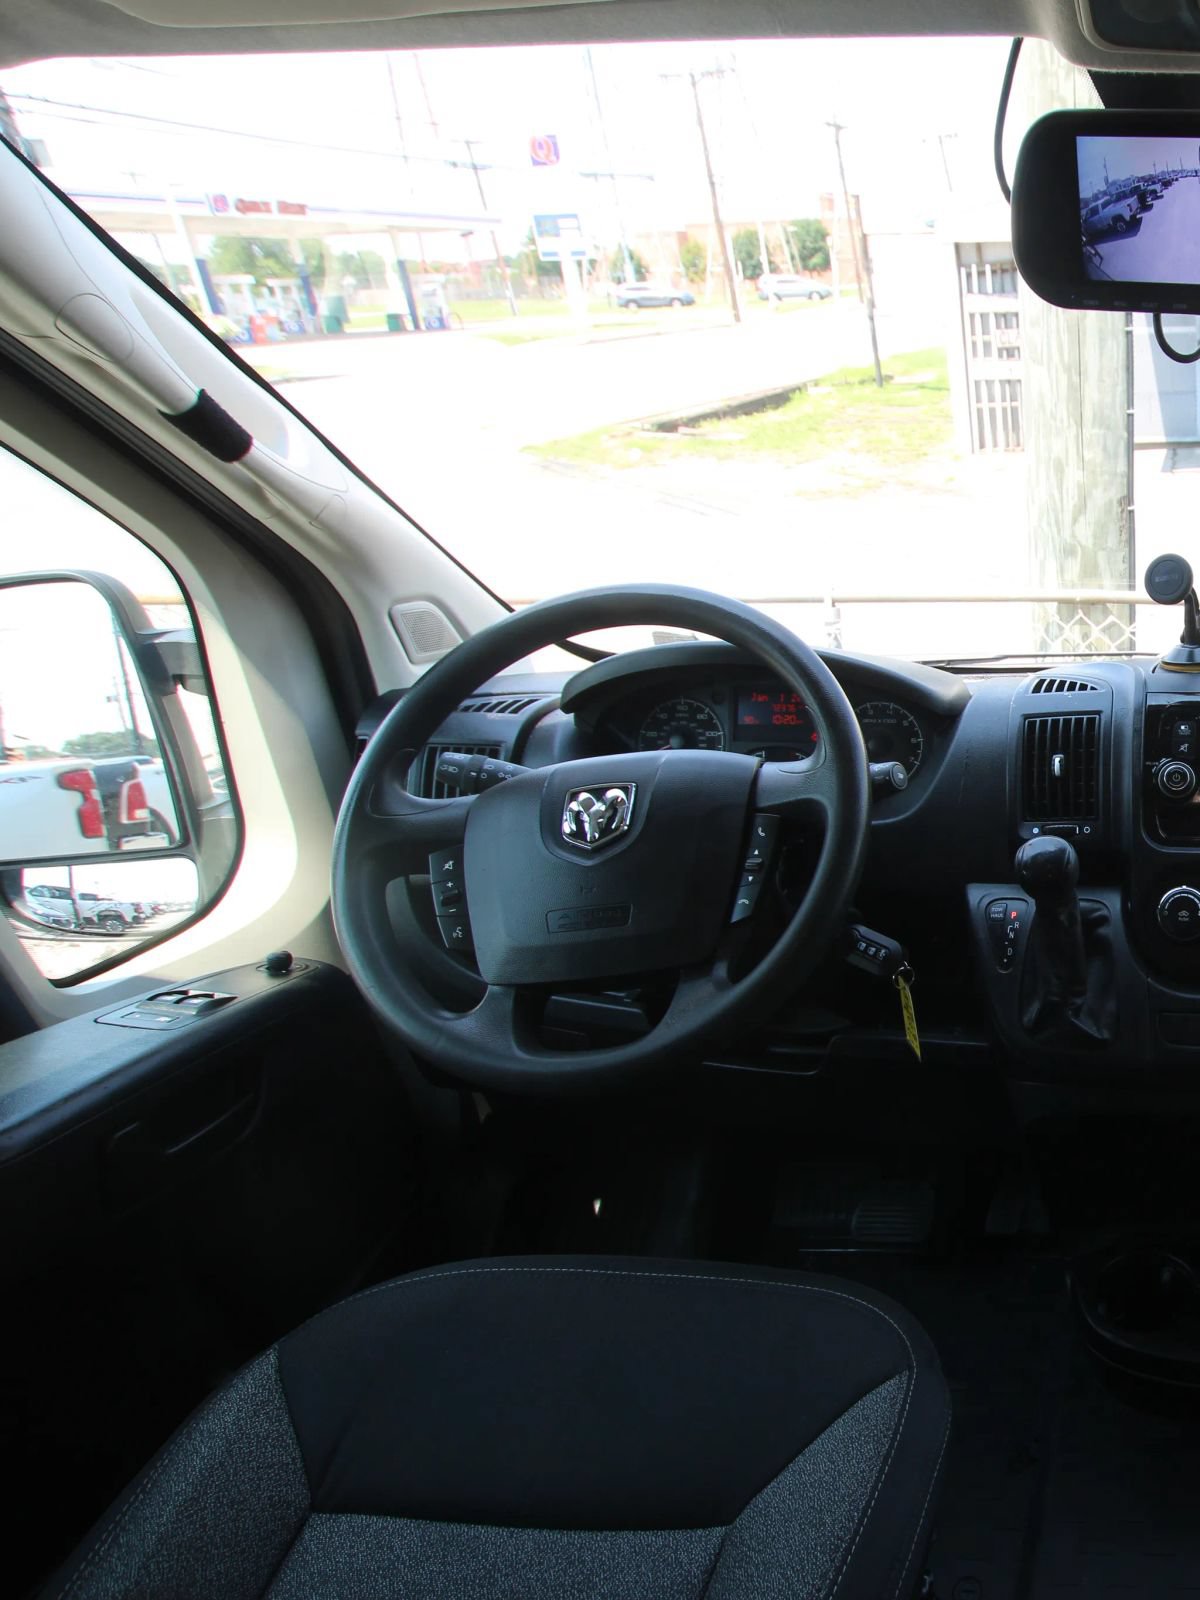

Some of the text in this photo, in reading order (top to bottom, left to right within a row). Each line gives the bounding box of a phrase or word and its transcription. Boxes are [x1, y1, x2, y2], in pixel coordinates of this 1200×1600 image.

[1011, 911, 1017, 919] P
[1014, 921, 1020, 929] R
[1008, 930, 1015, 939] N
[1007, 947, 1013, 956] D
